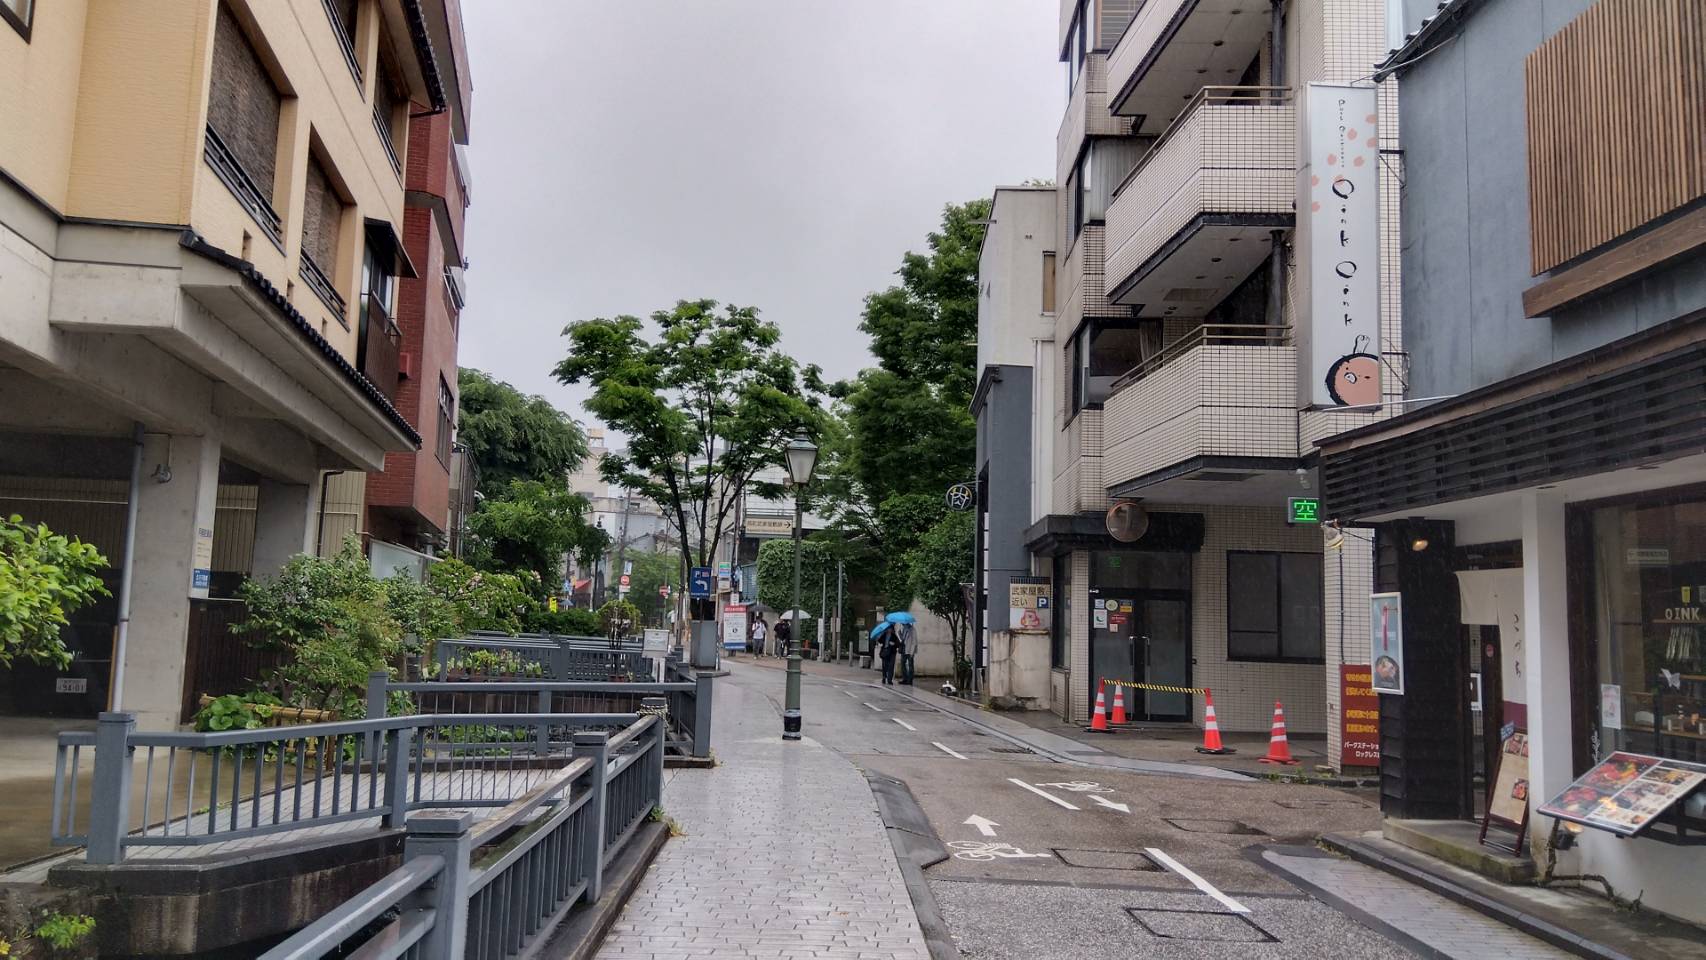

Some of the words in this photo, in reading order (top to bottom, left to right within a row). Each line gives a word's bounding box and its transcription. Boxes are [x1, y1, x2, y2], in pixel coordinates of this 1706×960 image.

[1332, 179, 1354, 247] Oink
[1335, 260, 1358, 327] Oink
[1294, 499, 1318, 521] 空
[1011, 586, 1050, 595] 武家屋敷
[1012, 597, 1028, 606] 近い
[1039, 598, 1047, 607] P
[1664, 607, 1700, 621] OINK
